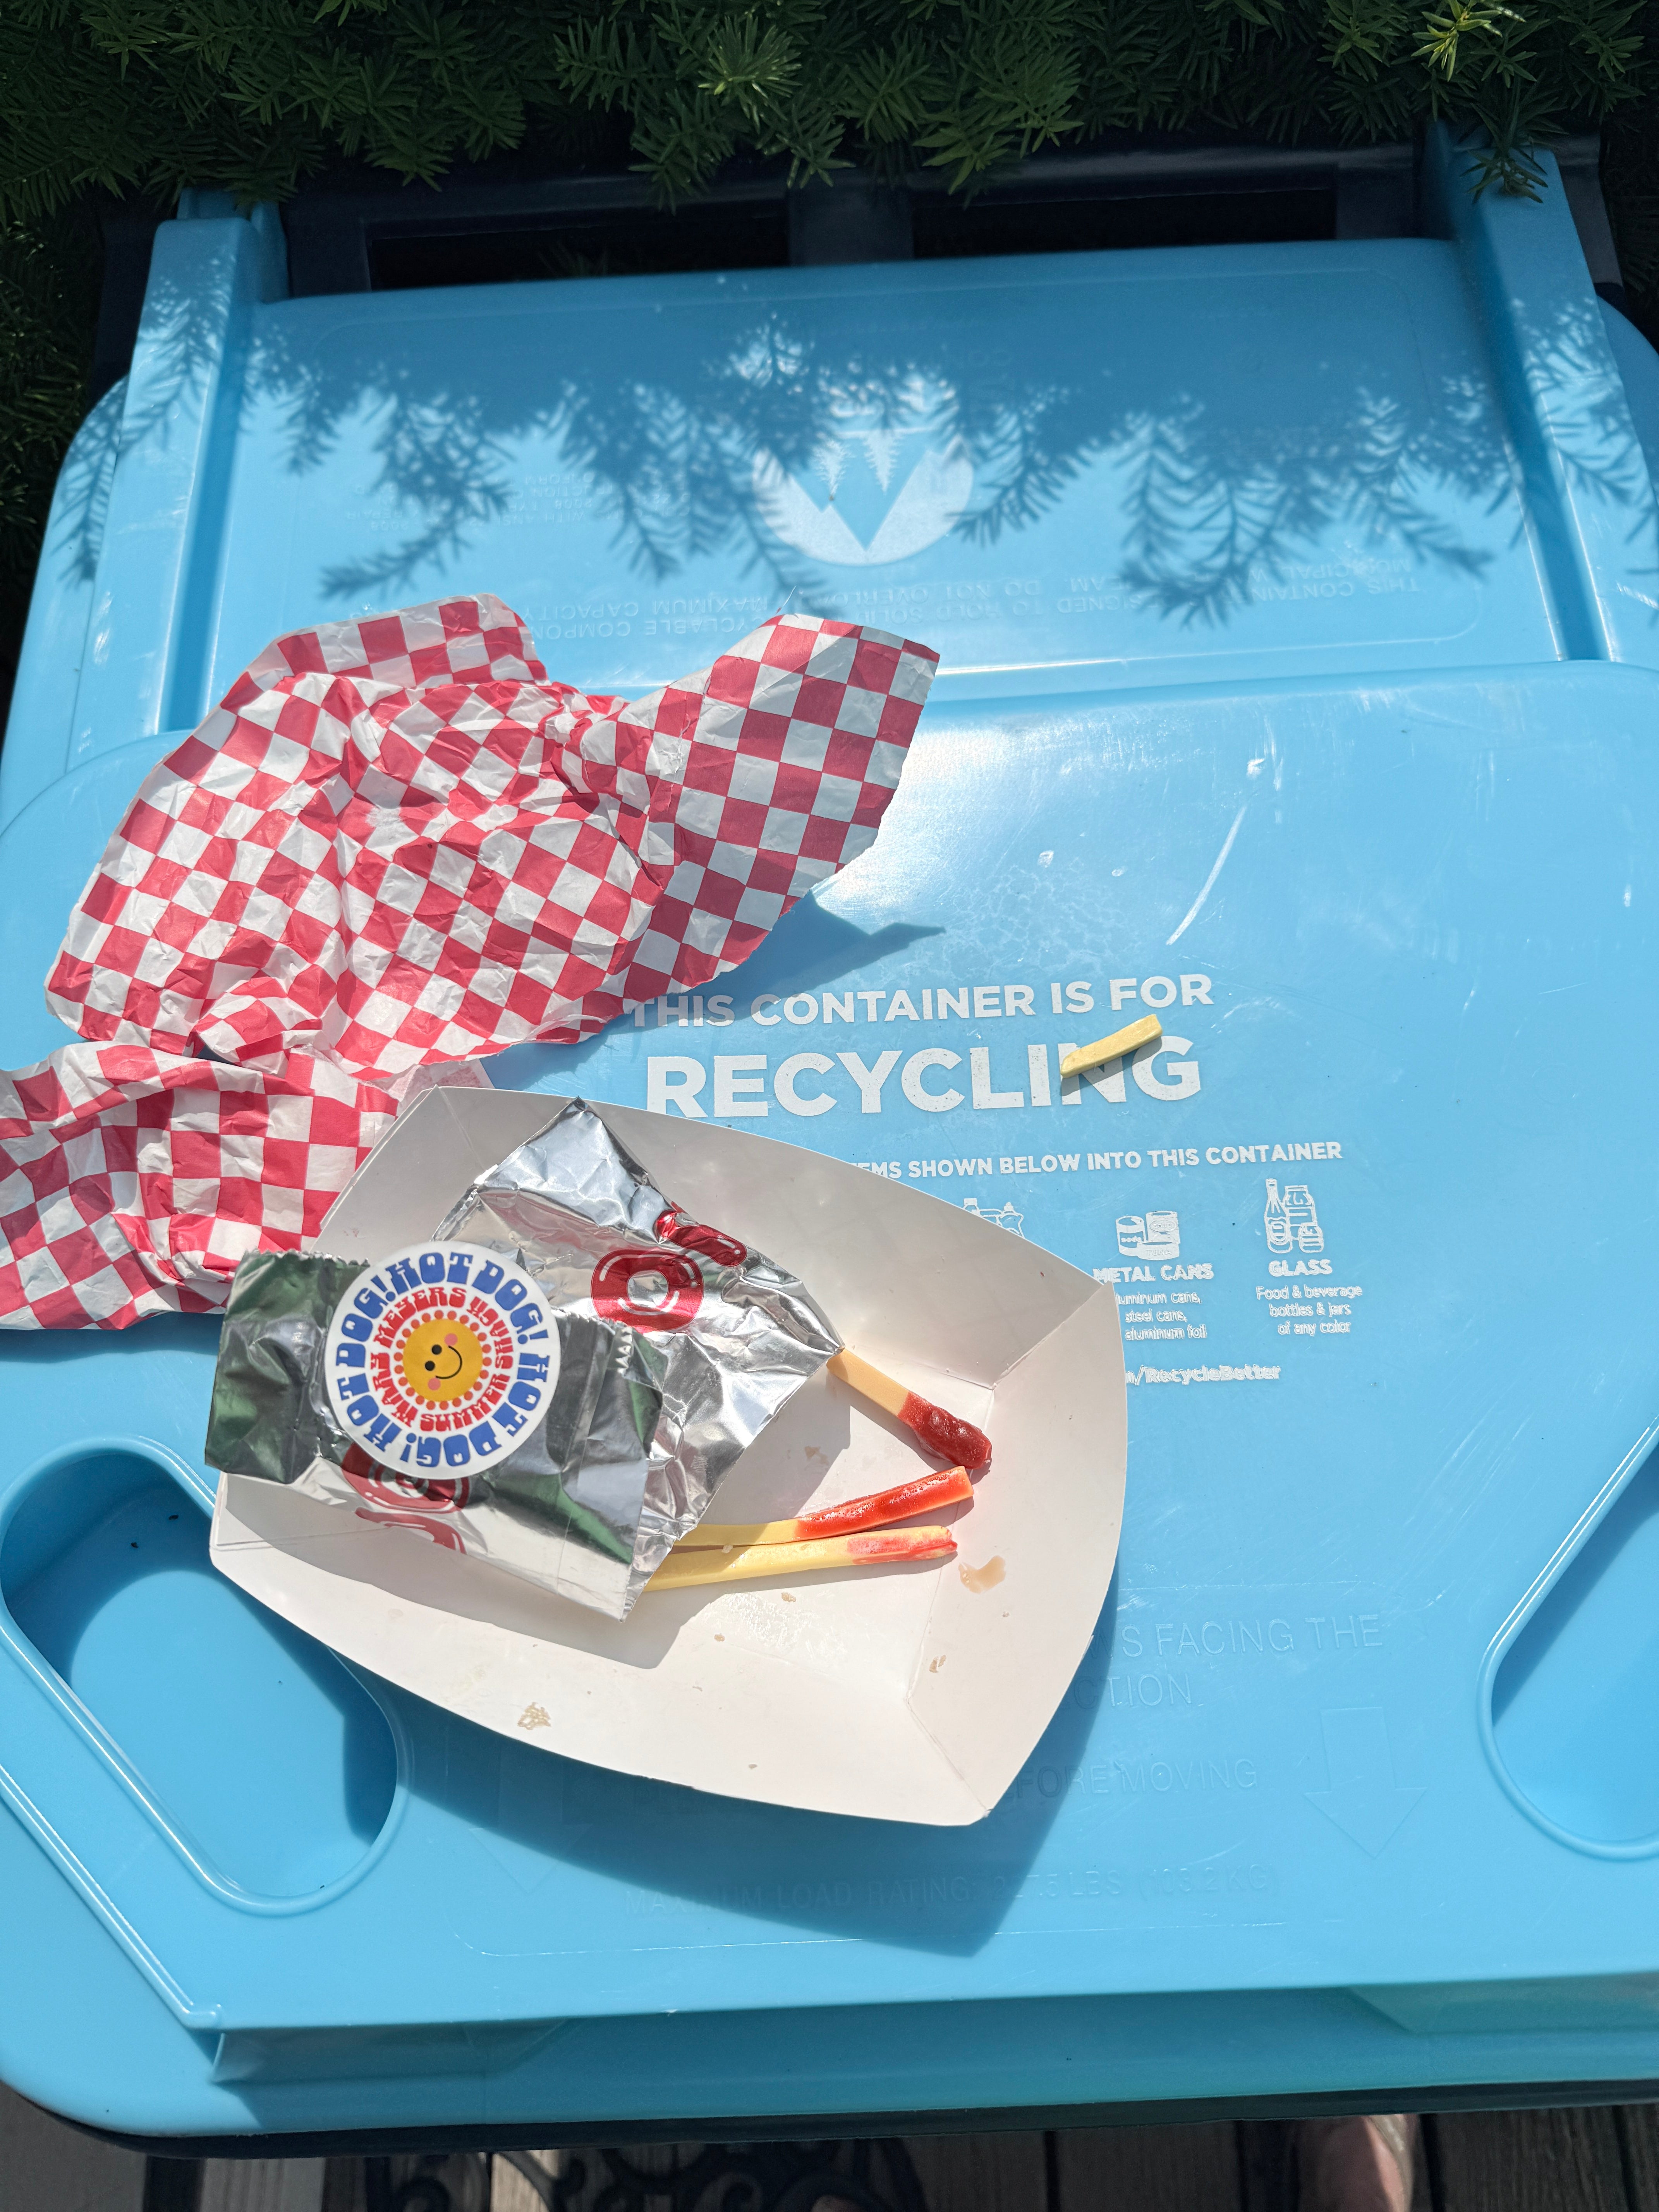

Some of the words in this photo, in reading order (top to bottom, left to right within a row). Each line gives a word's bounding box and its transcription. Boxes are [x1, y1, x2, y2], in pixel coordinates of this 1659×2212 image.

[523, 601, 639, 622] CAPACITY
[634, 994, 735, 1027] THIS
[750, 984, 1036, 1027] CONTAINER
[1051, 981, 1094, 1014] IS
[1111, 974, 1214, 1012] FOR
[647, 1036, 1201, 1118] RECYCLING
[908, 1158, 993, 1178] SHOWN
[999, 1153, 1081, 1174] BELOW
[1087, 1151, 1142, 1170] INTO
[1147, 1148, 1200, 1167] THIS
[1206, 1141, 1343, 1165] CONTAINER
[386, 1253, 472, 1294] HOT
[1092, 1265, 1156, 1283] METAL
[1160, 1263, 1214, 1281] CANS
[1269, 1259, 1333, 1277] GLASS
[472, 1261, 547, 1344] DOG!
[1115, 1291, 1168, 1305] luminum
[1170, 1292, 1202, 1304] cans,
[1256, 1286, 1289, 1300] Food
[1292, 1285, 1302, 1298] &
[1304, 1285, 1362, 1299] beverage
[1269, 1303, 1314, 1317] bottles
[1316, 1302, 1325, 1315] &
[1328, 1302, 1352, 1317] jars
[336, 1276, 395, 1367] DOG!
[374, 1287, 465, 1348] MEYERS
[1125, 1309, 1153, 1323] steel
[1156, 1310, 1187, 1322] cans,
[1125, 1326, 1185, 1340] aluminum
[1187, 1324, 1207, 1338] foil
[1278, 1321, 1290, 1335] of
[1294, 1323, 1316, 1336] any
[1319, 1319, 1351, 1333] color
[371, 1353, 417, 1427] WARY
[420, 1374, 510, 1431] SUMMER
[493, 1353, 549, 1436] HOT
[338, 1374, 400, 1451] HOT
[400, 1422, 500, 1467] DOG!
[1155, 1618, 1294, 1656] FACING
[1305, 1614, 1383, 1649] THE
[1121, 1759, 1258, 1793] MOVING
